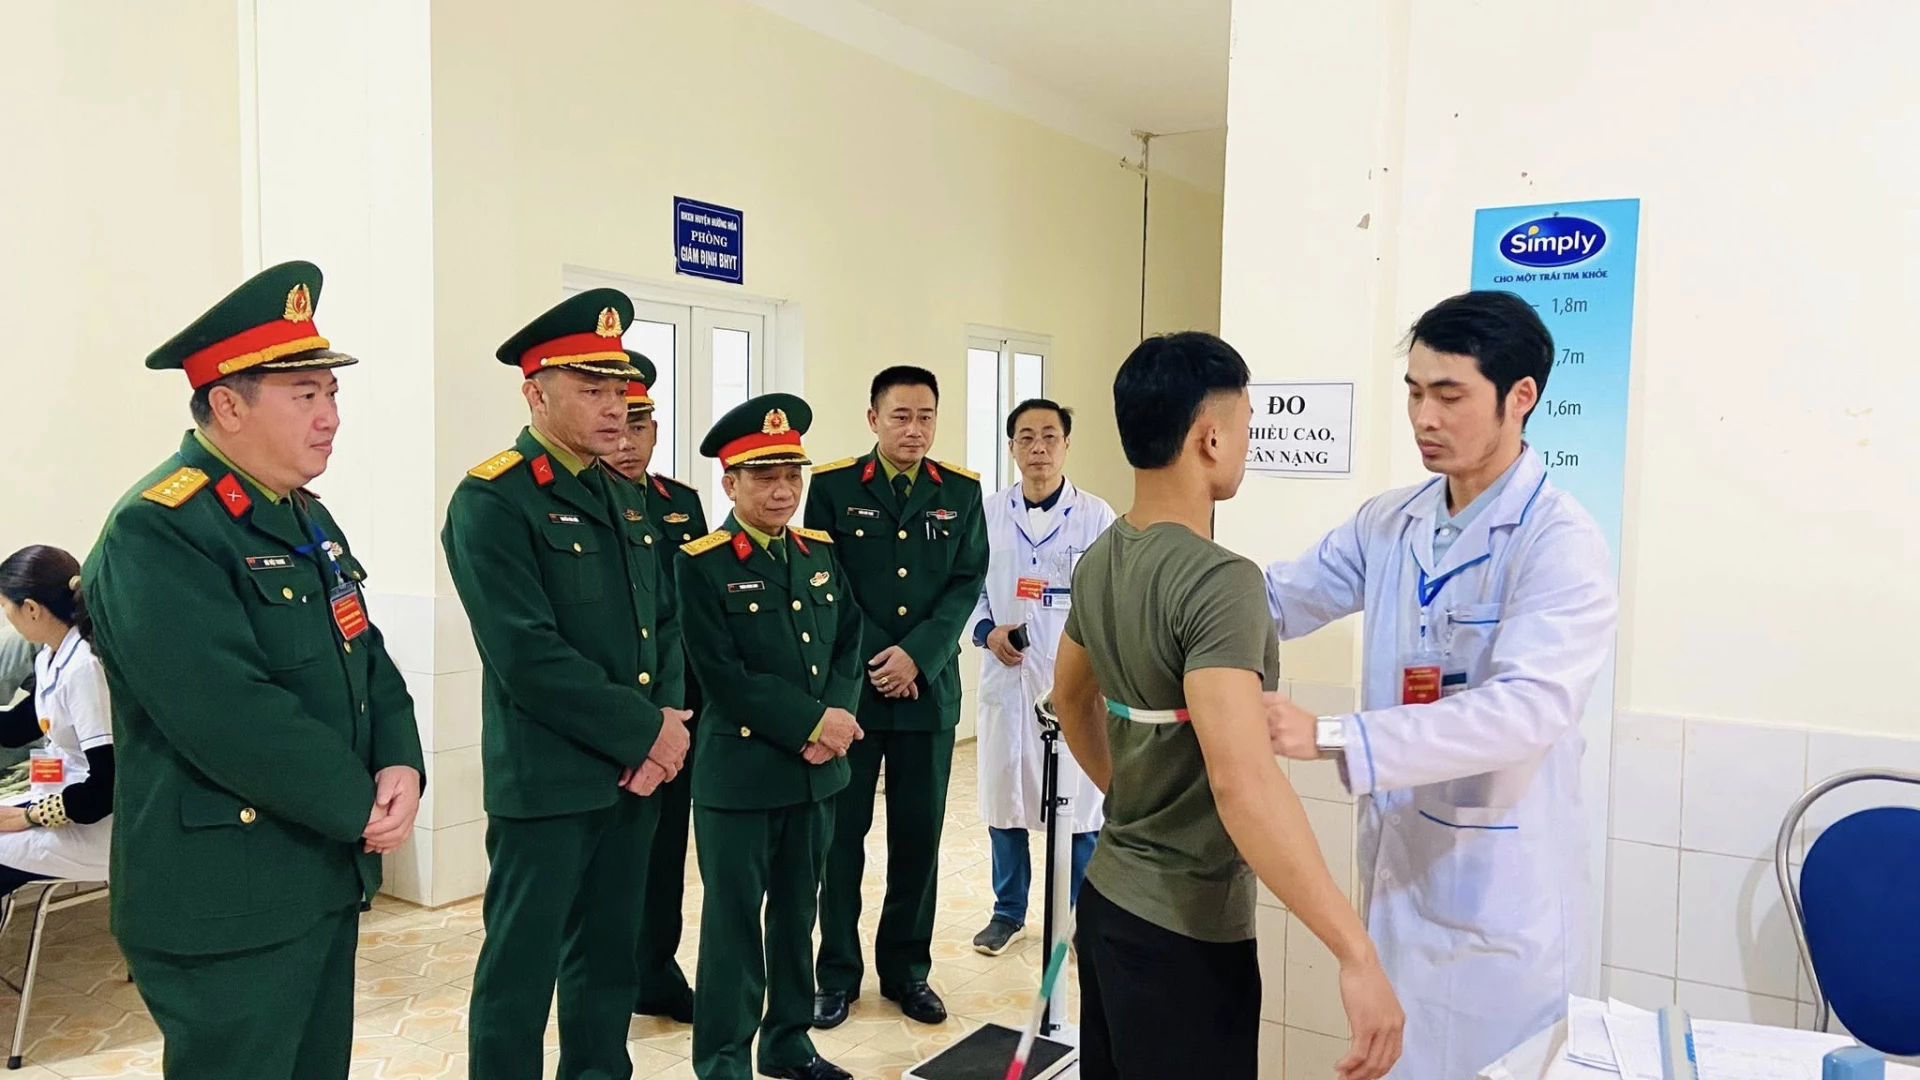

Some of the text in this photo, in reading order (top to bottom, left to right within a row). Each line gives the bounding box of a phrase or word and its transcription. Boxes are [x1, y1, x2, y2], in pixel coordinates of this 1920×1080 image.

[694, 213, 710, 227] HUYỆN
[690, 230, 728, 247] PHÒNG
[1510, 225, 1597, 255] Simply
[680, 243, 738, 270] GIÁM ĐỊNH BHYT
[1493, 268, 1608, 283] CHO MỘT TRÁI TIM KHỎE
[1551, 297, 1587, 315] 1,8m
[1556, 348, 1585, 367] ,7m
[1266, 395, 1306, 415] ĐO
[1546, 400, 1581, 417] 1,6m
[1248, 423, 1335, 443] HIỀU CAO,
[1279, 449, 1328, 467] NẶNG
[1543, 451, 1579, 468] 1,5m
